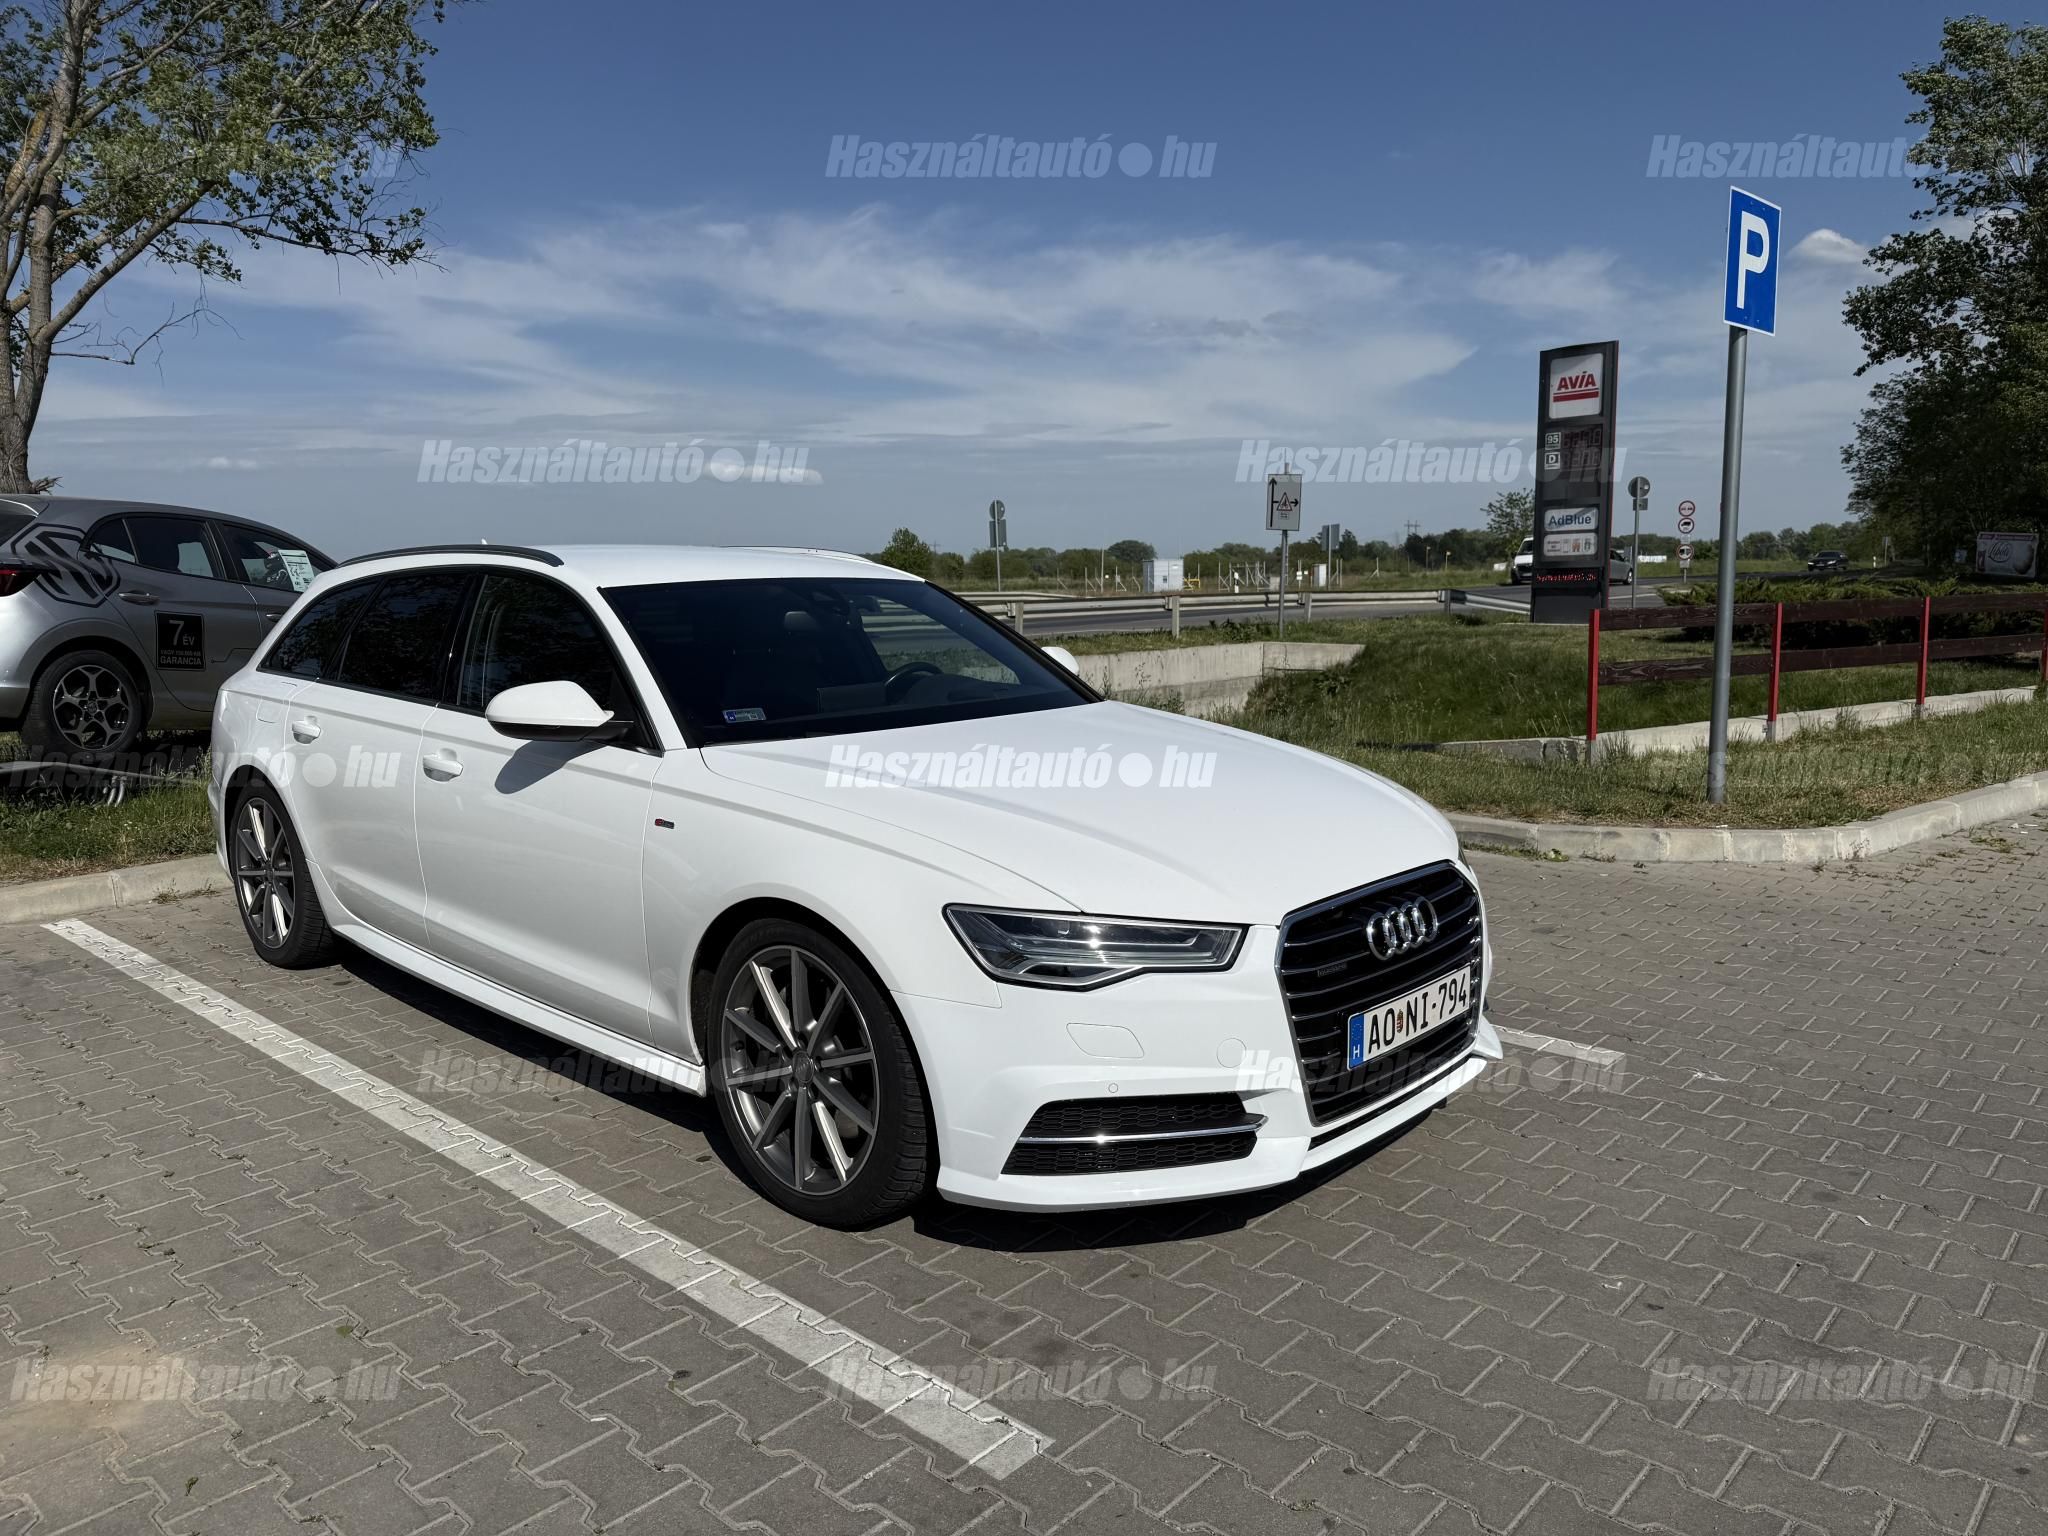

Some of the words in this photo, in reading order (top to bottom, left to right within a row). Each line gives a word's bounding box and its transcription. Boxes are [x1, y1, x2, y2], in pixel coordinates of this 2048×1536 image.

[1736, 210, 1770, 309] P
[1547, 435, 1559, 444] 95
[1548, 454, 1556, 463] D
[1548, 514, 1592, 526] AdBlue
[168, 619, 185, 646] 7
[160, 655, 202, 665] GARANCIA
[1367, 1012, 1396, 1054] AO
[1352, 1046, 1360, 1058] H
